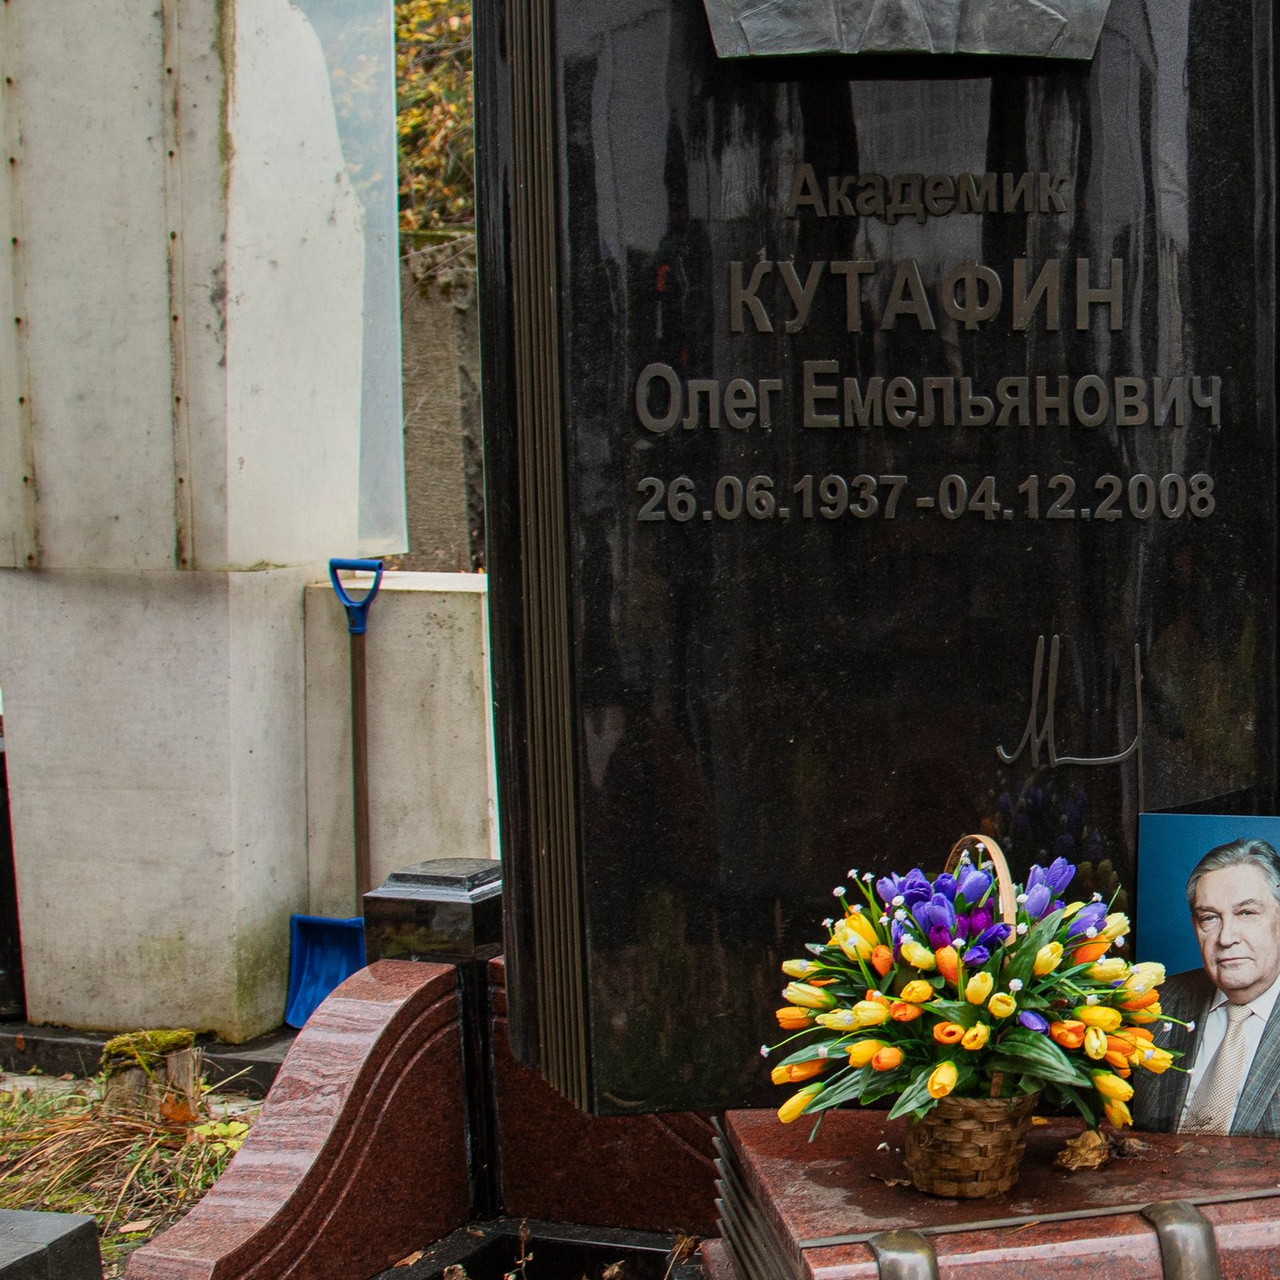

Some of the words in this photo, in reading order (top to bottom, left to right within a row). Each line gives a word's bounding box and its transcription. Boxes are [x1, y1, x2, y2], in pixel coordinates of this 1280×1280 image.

[786, 163, 1068, 224] Академик
[729, 257, 1123, 333] КУТАФИН
[635, 362, 782, 433] Олег
[803, 359, 1222, 431] Емельянович
